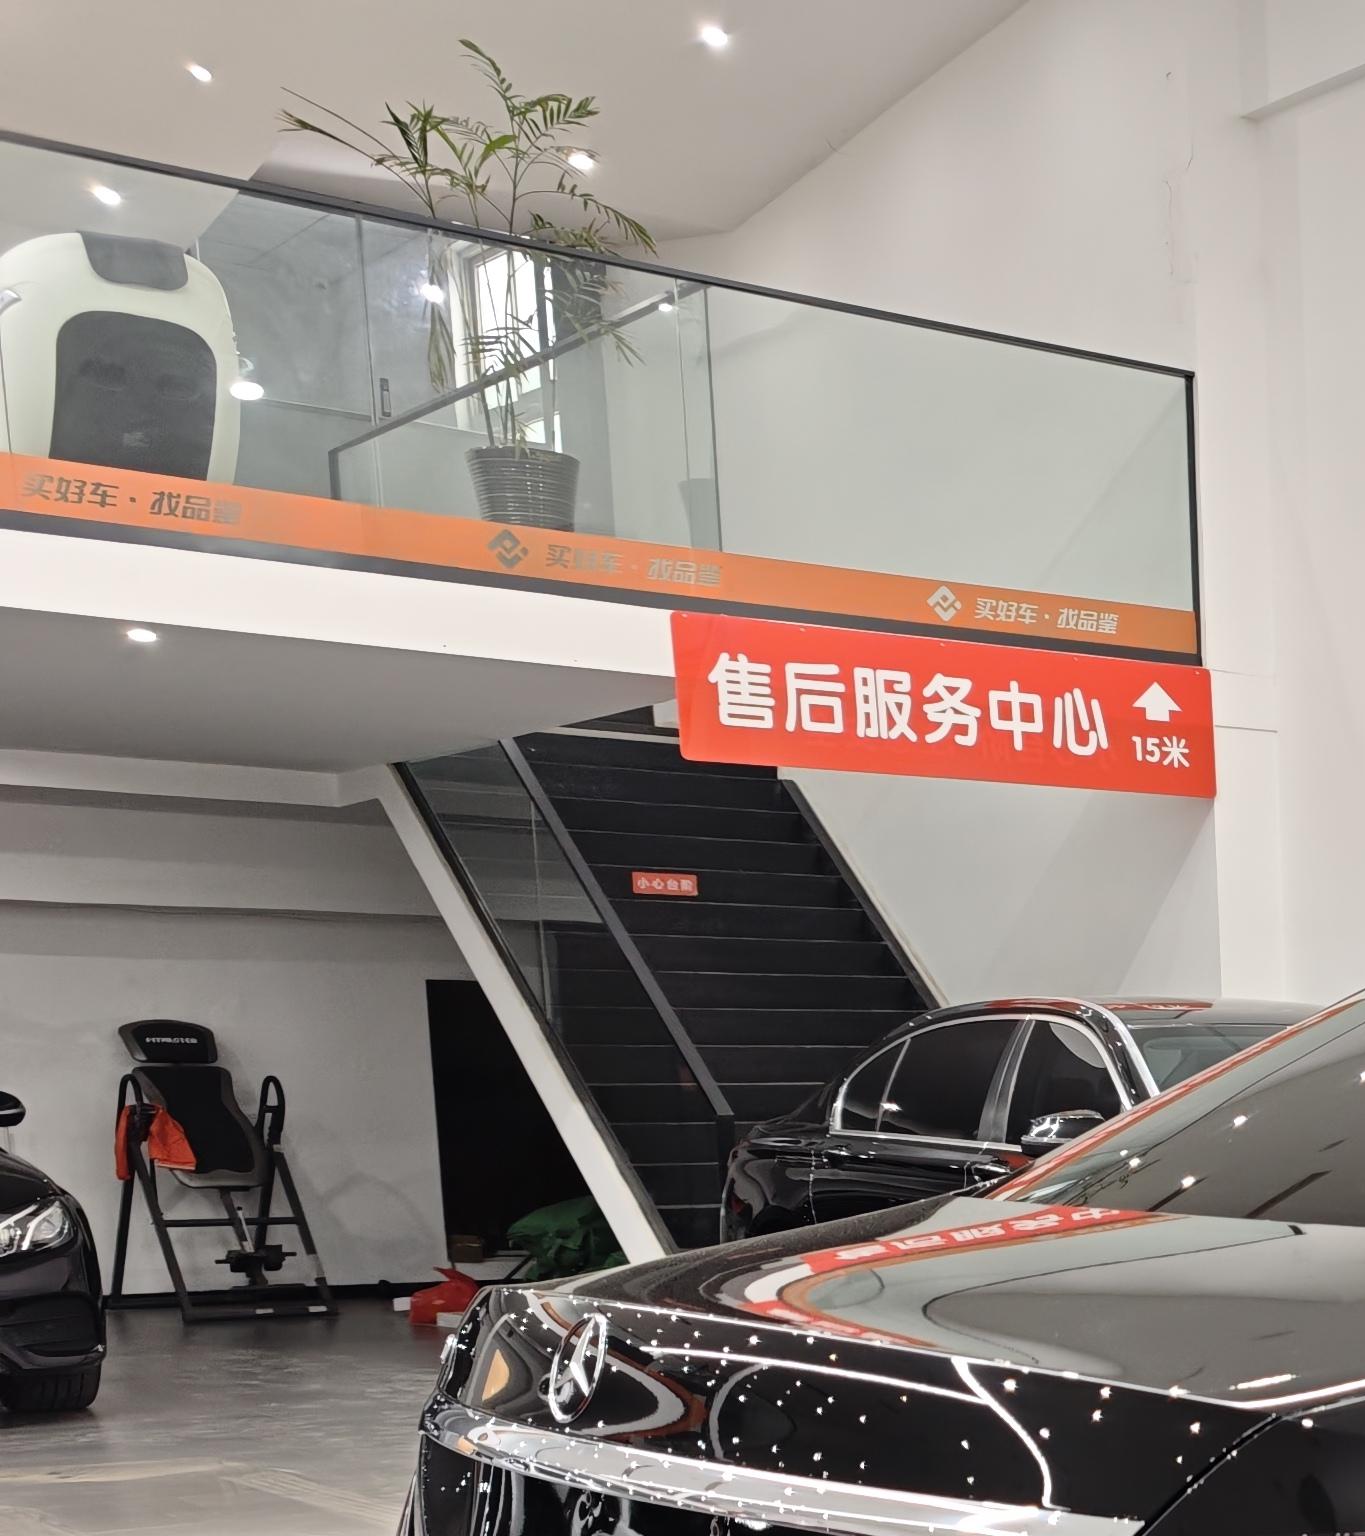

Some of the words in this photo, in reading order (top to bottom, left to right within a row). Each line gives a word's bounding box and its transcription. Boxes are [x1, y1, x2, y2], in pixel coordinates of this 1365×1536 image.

[708, 652, 1109, 756] 售后服务中心
[1132, 735, 1190, 768] 15米
